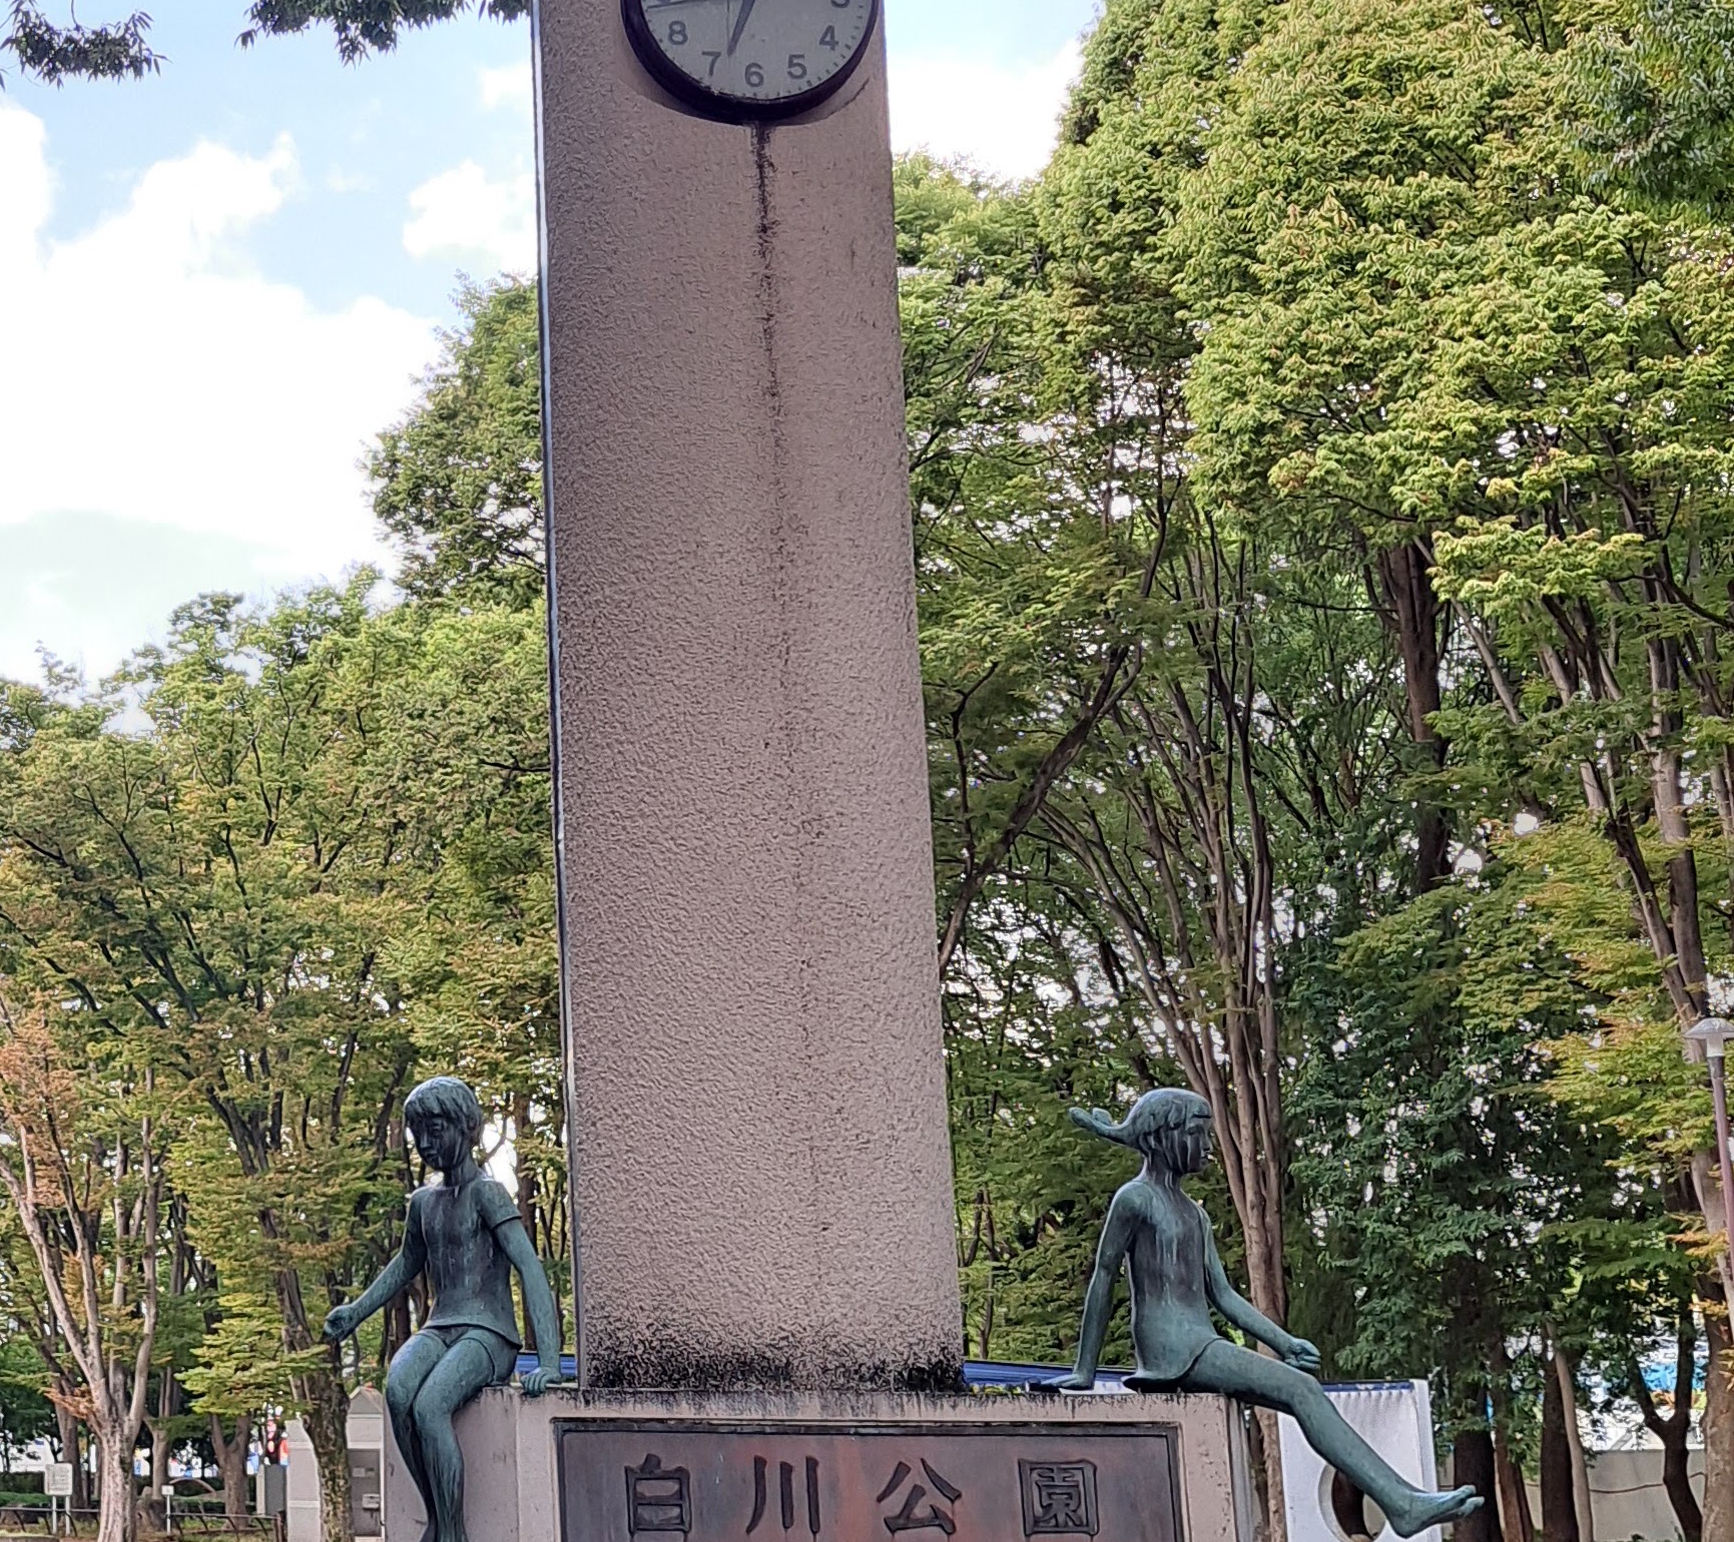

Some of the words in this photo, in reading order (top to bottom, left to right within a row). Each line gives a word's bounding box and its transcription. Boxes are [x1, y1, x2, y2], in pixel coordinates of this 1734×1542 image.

[668, 20, 688, 45] 8
[819, 25, 839, 51] 4
[702, 51, 722, 76] 7
[744, 63, 764, 87] 6
[787, 54, 807, 79] 5
[624, 1453, 1099, 1537] 白川公園
